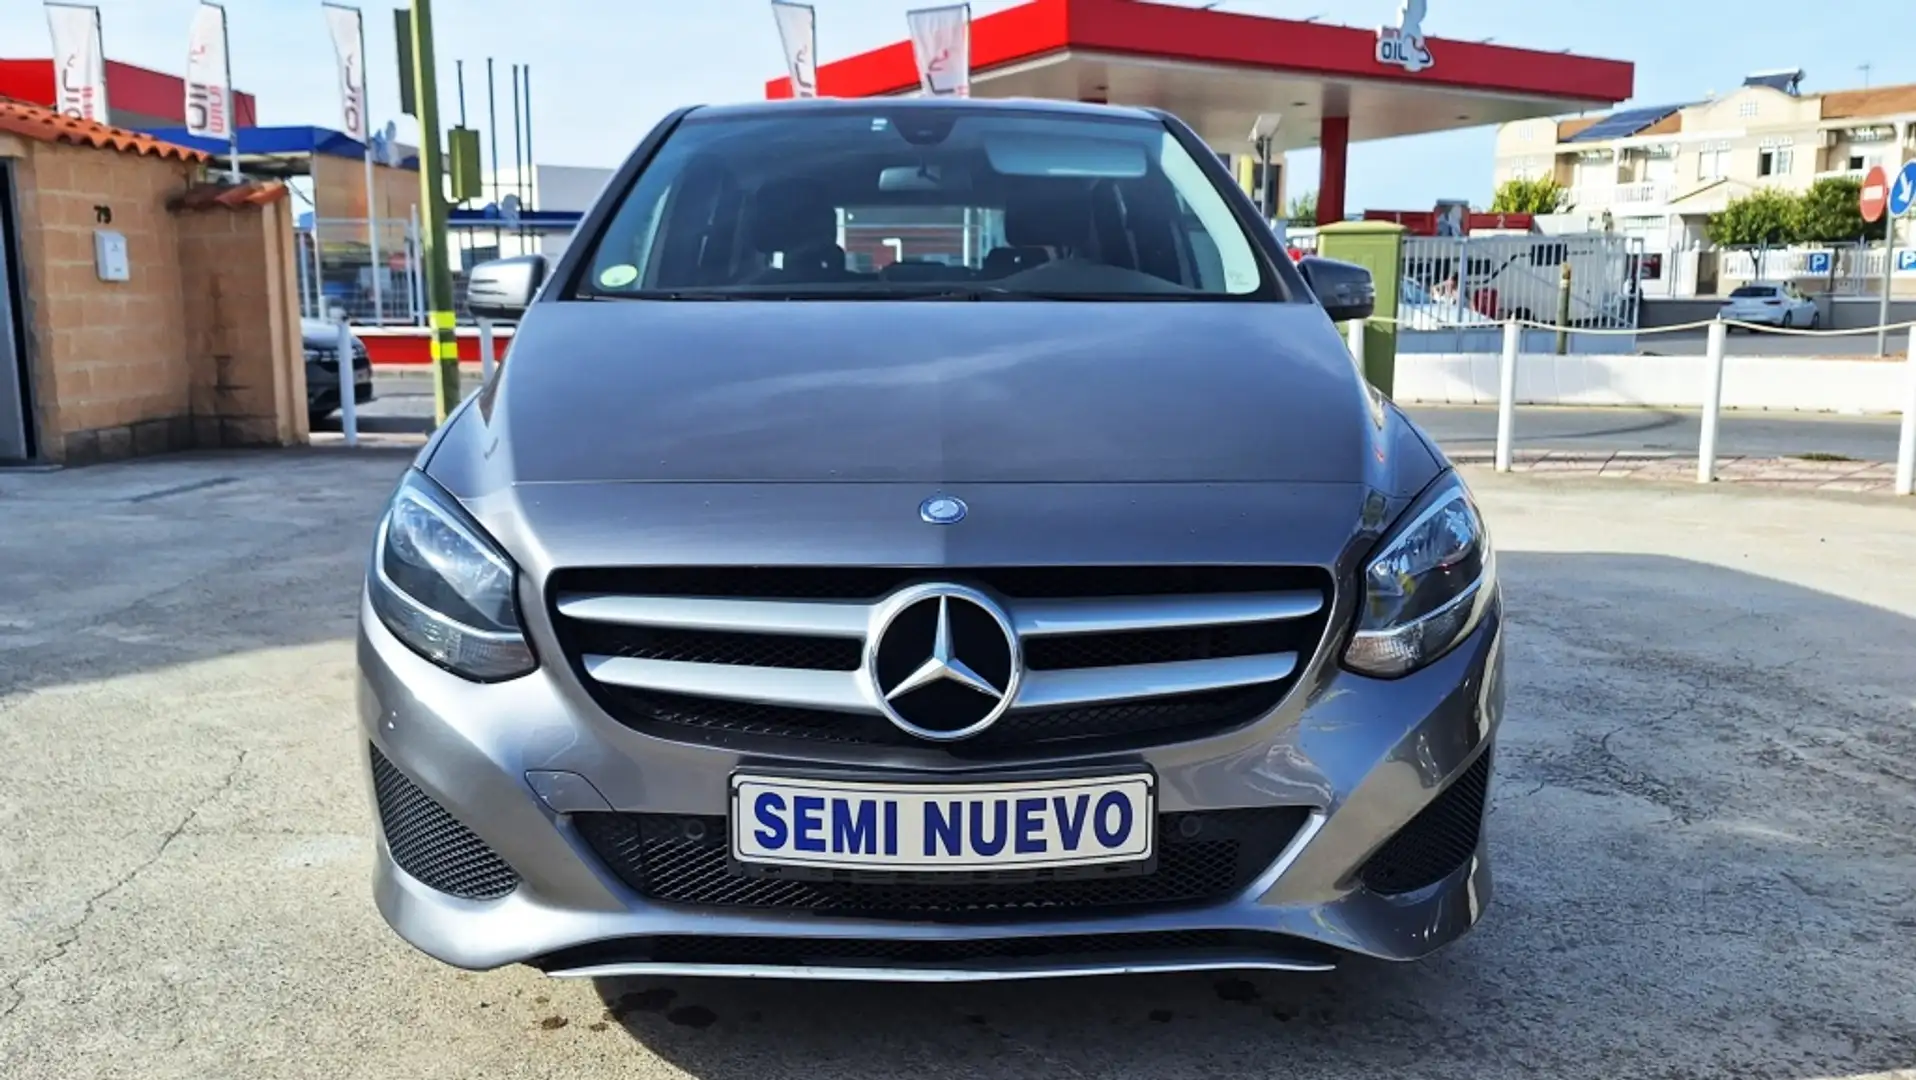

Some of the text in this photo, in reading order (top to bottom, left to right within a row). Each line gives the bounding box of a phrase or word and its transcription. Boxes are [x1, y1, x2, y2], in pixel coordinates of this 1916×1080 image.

[1381, 41, 1409, 61] OIL
[94, 205, 112, 225] 79
[1812, 254, 1826, 272] P
[754, 790, 1133, 857] SEMI NUEVO
